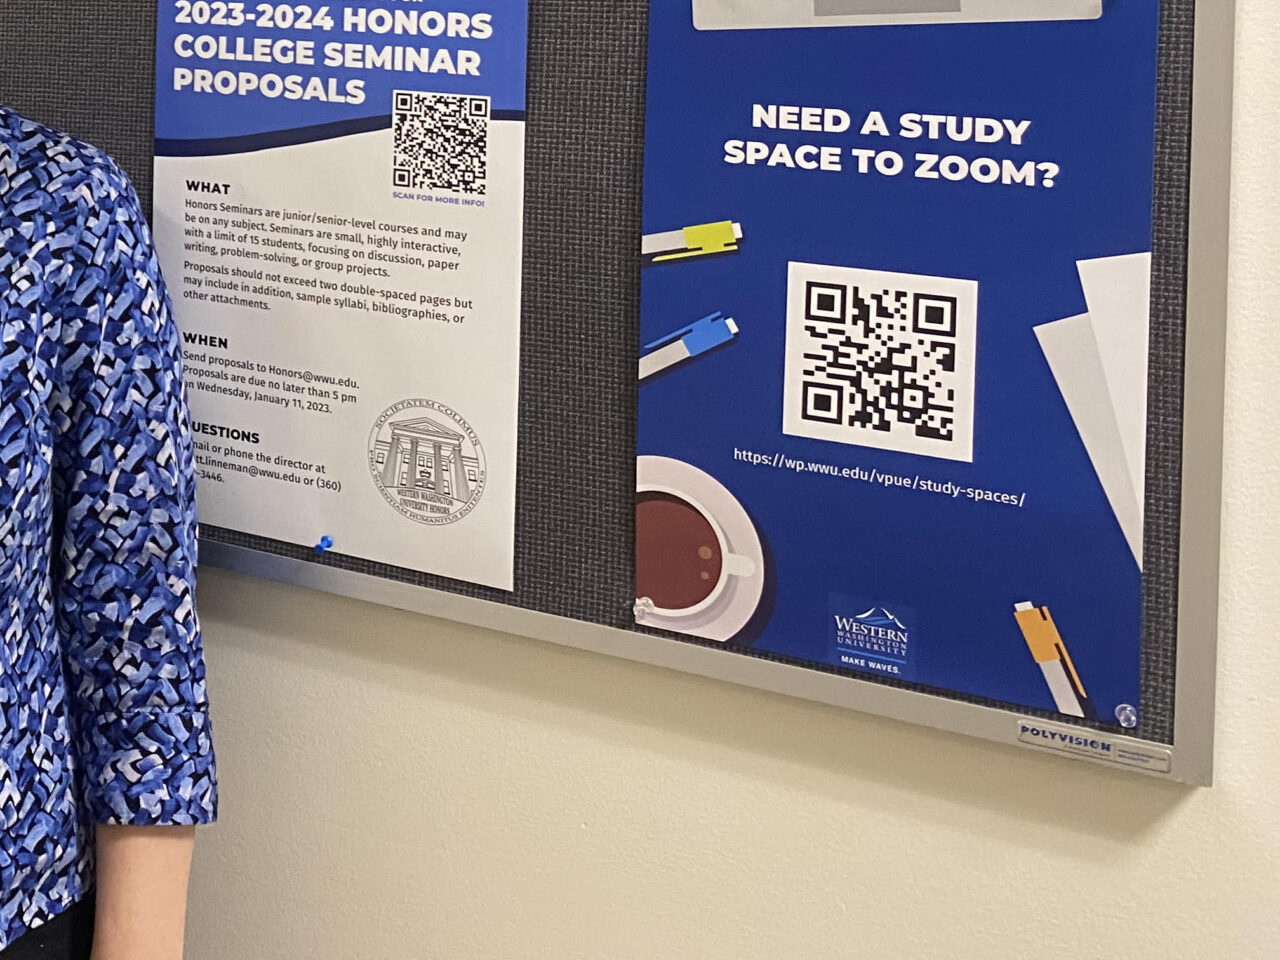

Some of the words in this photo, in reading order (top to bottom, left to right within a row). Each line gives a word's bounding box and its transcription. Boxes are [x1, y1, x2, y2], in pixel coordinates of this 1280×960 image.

[173, 0, 334, 32] 2023-2024
[343, 8, 494, 40] HONORS
[174, 34, 315, 64] COLLEGE
[323, 42, 481, 75] SEMINAR
[173, 68, 366, 103] PROPOSALS
[752, 104, 851, 132] NEED
[860, 111, 890, 136] A
[899, 113, 1031, 144] STUDY
[723, 140, 842, 170] SPACE
[851, 148, 904, 175] TO
[914, 153, 1059, 187] ZOOM?
[185, 180, 231, 194] WHAT
[392, 191, 415, 200] SCAN
[416, 193, 433, 202] FOR
[434, 196, 460, 205] MORE
[461, 198, 485, 207] INFO!
[184, 198, 218, 211] Honors
[219, 202, 263, 216] Seminars
[264, 209, 281, 218] are
[282, 209, 376, 229] junior/senior-level
[378, 222, 419, 234] courses
[421, 227, 441, 237] and
[444, 230, 467, 242] may
[184, 212, 196, 228] be
[198, 215, 210, 224] on
[212, 217, 229, 229] any
[230, 219, 267, 231] subject.
[269, 222, 314, 237] Seminars
[316, 230, 332, 239] are
[334, 232, 364, 245] small,
[367, 234, 398, 249] highly
[400, 238, 461, 256] interactive,
[183, 227, 204, 243] with
[205, 231, 212, 239] a
[214, 230, 235, 242] limit
[237, 233, 248, 243] of
[249, 235, 260, 245] 15
[261, 237, 306, 252] students,
[307, 242, 350, 259] focusing
[351, 249, 365, 258] on
[367, 249, 425, 267] discussion,
[427, 259, 459, 271] paper
[183, 260, 230, 275] Proposals
[231, 267, 263, 280] should
[265, 273, 281, 283] not
[283, 275, 317, 288] exceed
[319, 280, 338, 291] two
[340, 282, 417, 301] double-spaced
[419, 295, 451, 307] pages
[454, 296, 473, 309] but
[182, 332, 227, 349] WHEN
[183, 350, 206, 363] Send
[208, 356, 255, 370] proposals
[256, 363, 267, 373] to
[268, 365, 359, 388] Honors@wwu.edu.
[183, 365, 229, 380] Proposals
[230, 374, 246, 384] are
[248, 376, 266, 387] due
[268, 380, 280, 390] no
[282, 381, 306, 394] later
[307, 386, 330, 398] than
[332, 390, 339, 400] 5
[341, 393, 357, 403] pm
[196, 381, 252, 400] Wednesday,
[253, 391, 290, 408] January
[292, 398, 304, 410] 11,
[306, 400, 332, 413] 2023.
[192, 421, 259, 443] UESTIONS
[212, 445, 221, 454] or
[224, 446, 254, 461] phone
[256, 452, 271, 464] the
[274, 455, 313, 472] director
[315, 464, 326, 474] at
[733, 449, 1026, 505] https://wp.wwu.edu/vpue/study-spaces/
[834, 615, 908, 643] WESTERN
[837, 631, 907, 649] WASHINGTON
[837, 637, 906, 656] UNIVERSITY
[841, 656, 865, 666] MAKE
[868, 661, 901, 674] WAVES.
[1021, 725, 1111, 752] POLYVISION
